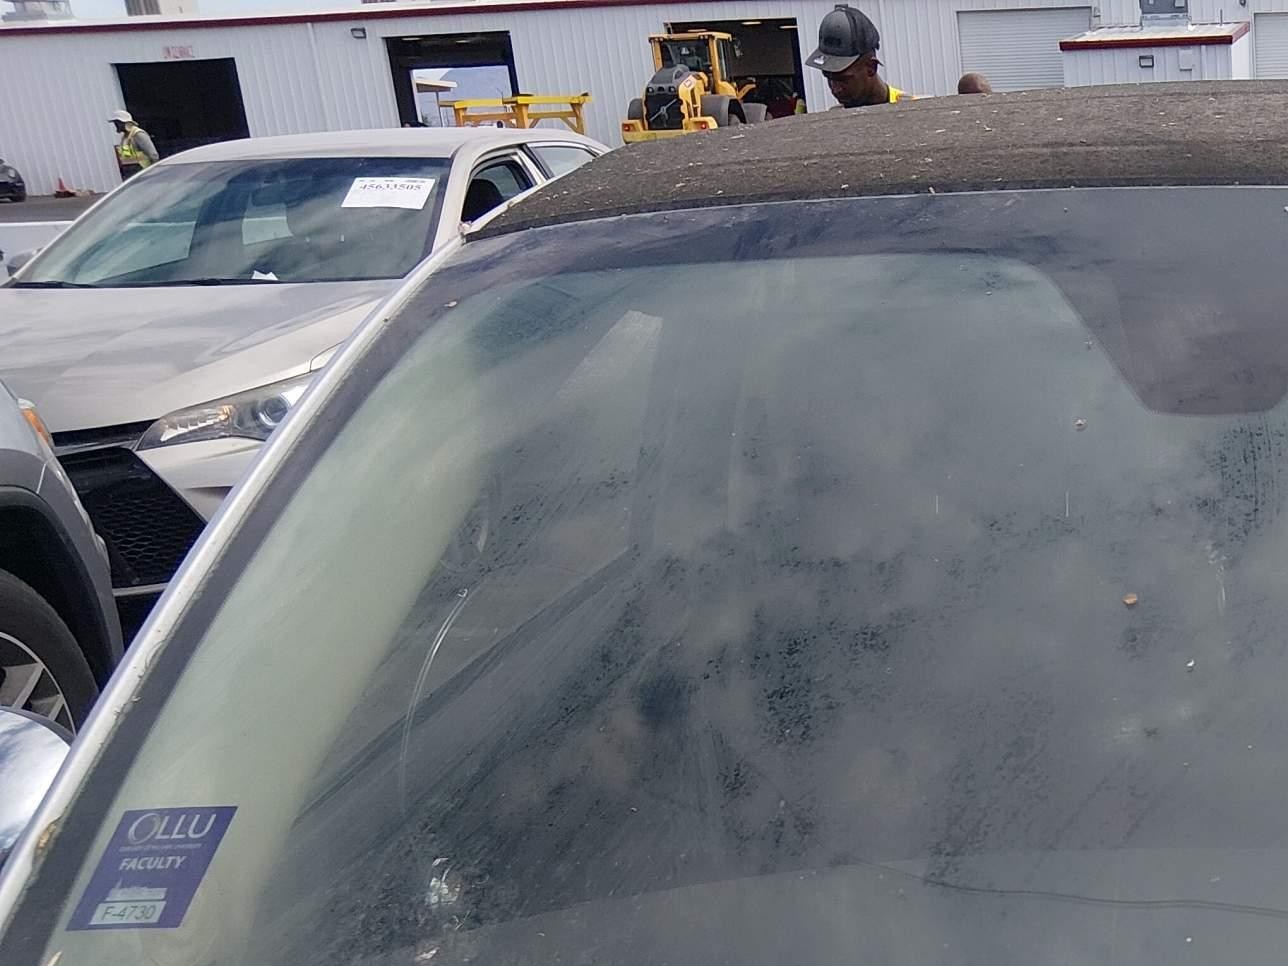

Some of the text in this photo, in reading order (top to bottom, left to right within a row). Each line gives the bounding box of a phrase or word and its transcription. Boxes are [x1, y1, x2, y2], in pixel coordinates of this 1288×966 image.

[128, 812, 217, 845] OLLU
[118, 855, 188, 871] FACULTY
[101, 904, 157, 921] F-4730
